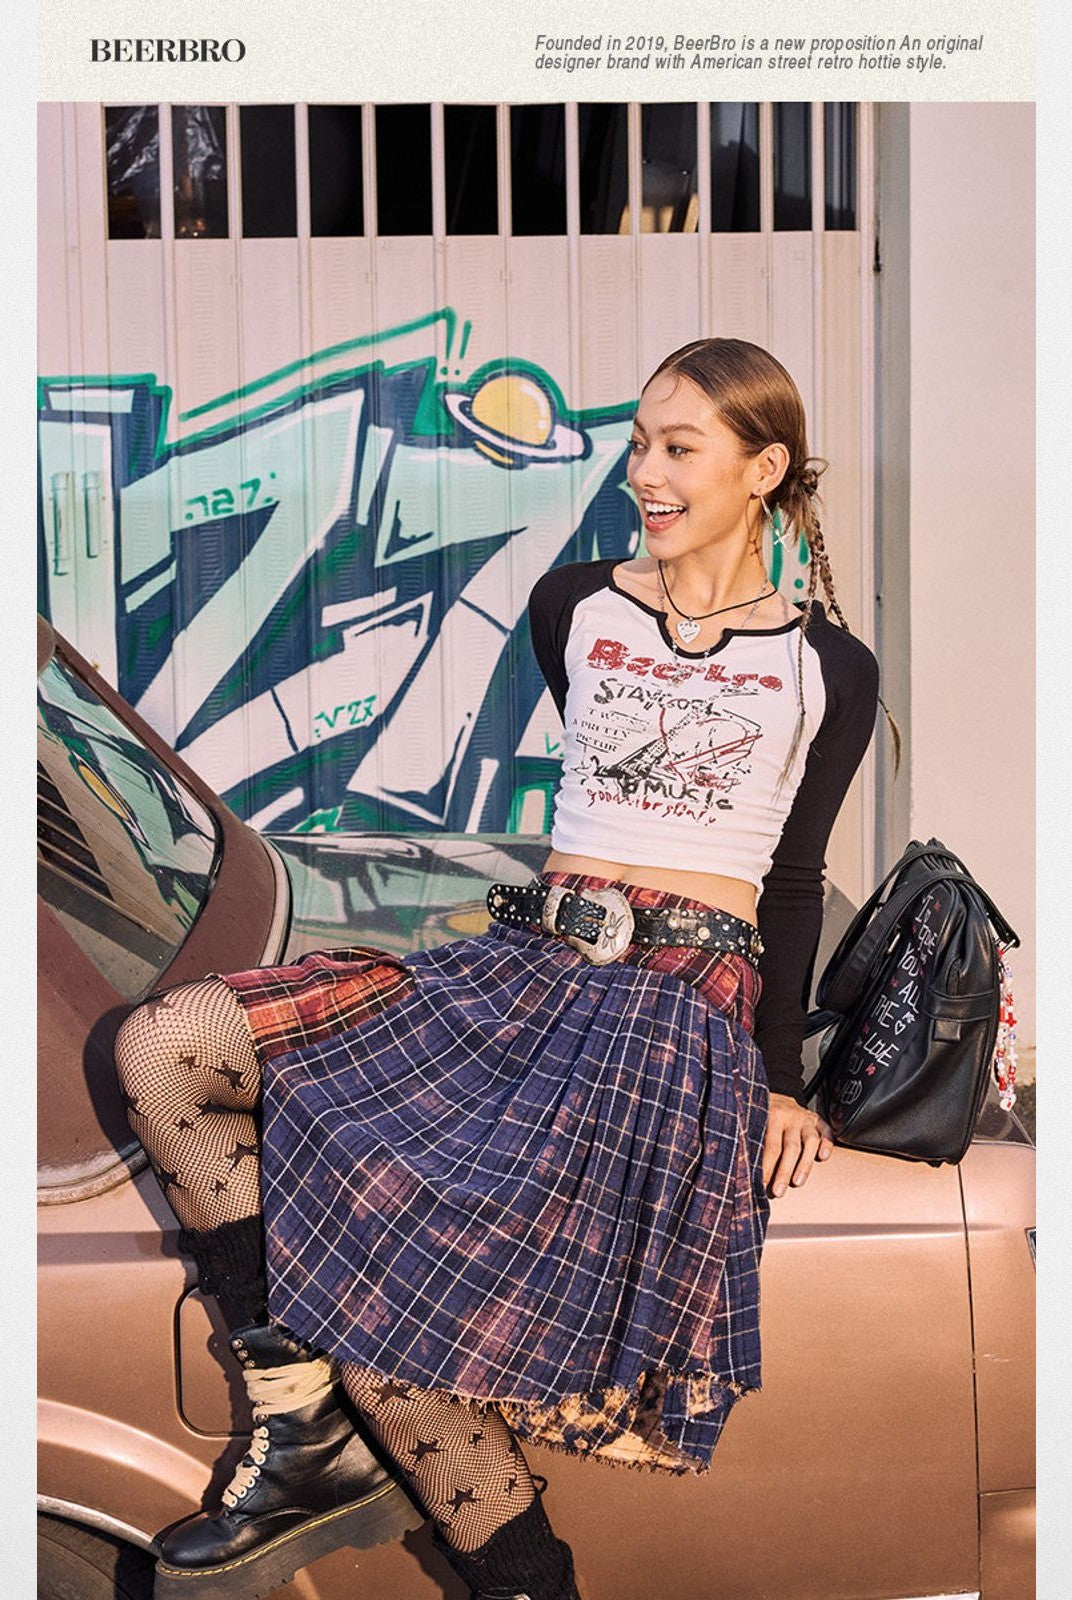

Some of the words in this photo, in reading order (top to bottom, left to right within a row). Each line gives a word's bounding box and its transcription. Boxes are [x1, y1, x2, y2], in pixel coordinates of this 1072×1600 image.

[897, 942, 920, 977] YOU
[871, 994, 900, 1029] THE
[863, 1032, 900, 1067] LOVE
